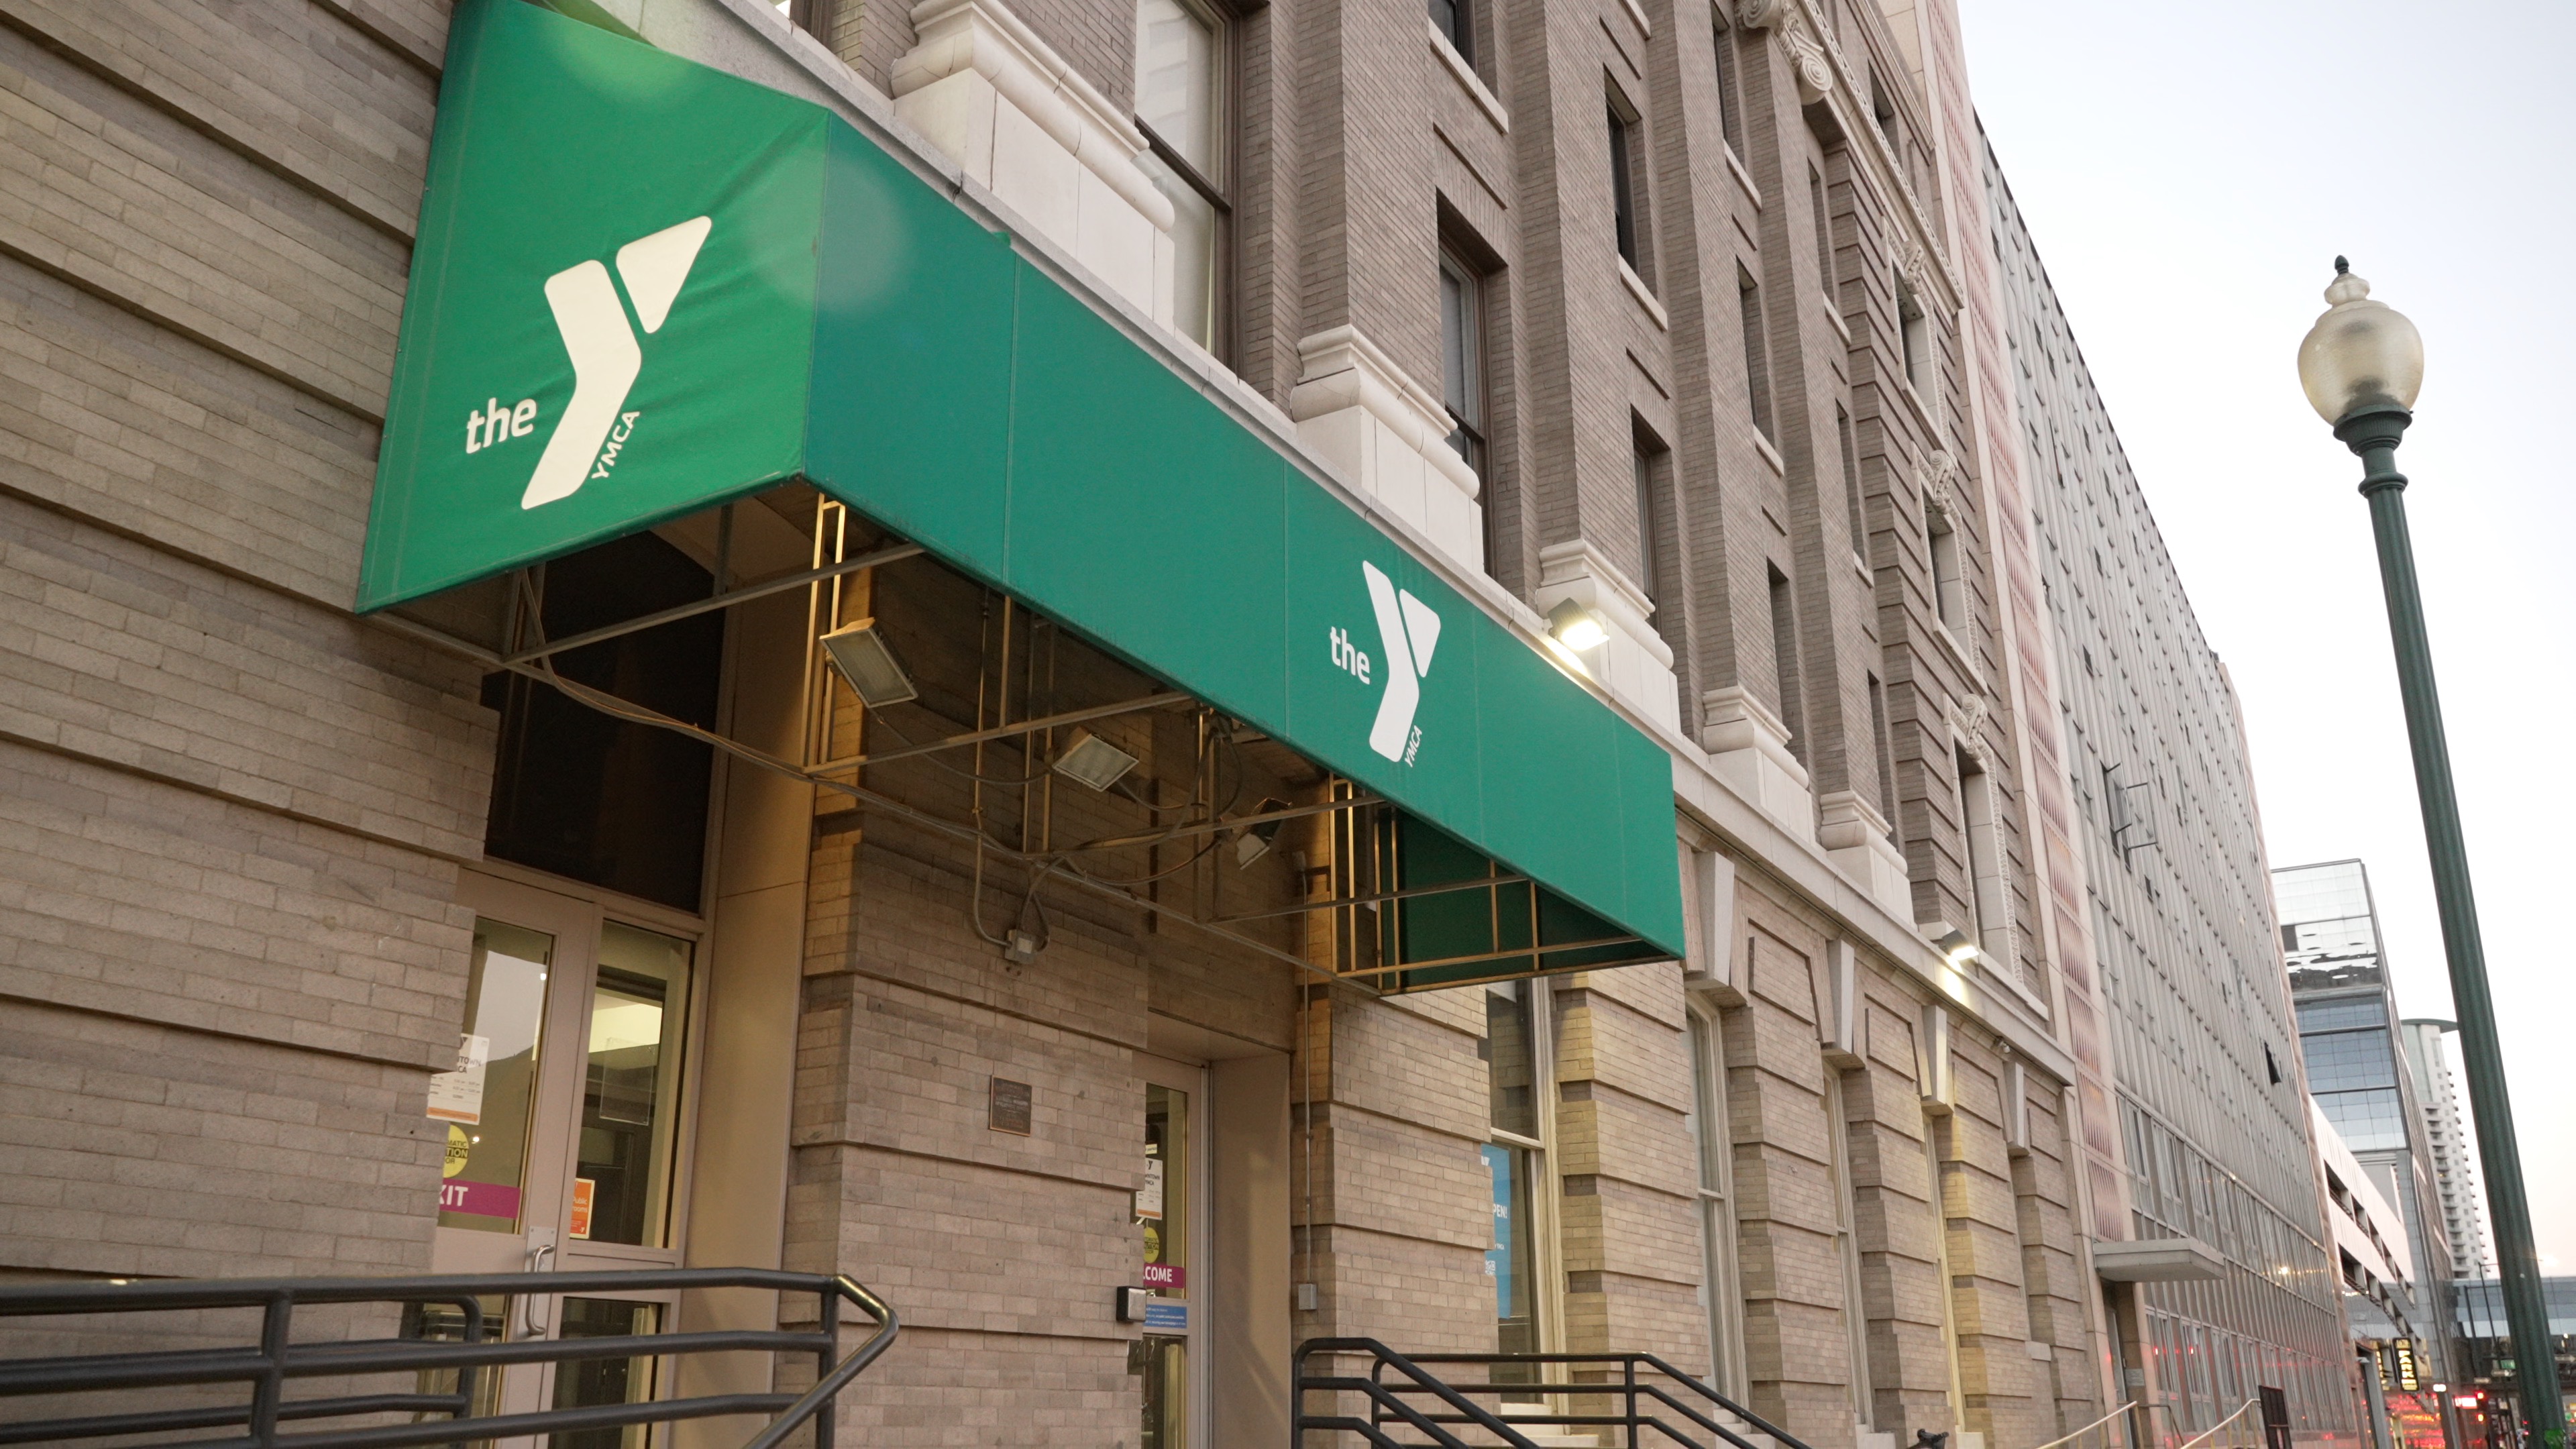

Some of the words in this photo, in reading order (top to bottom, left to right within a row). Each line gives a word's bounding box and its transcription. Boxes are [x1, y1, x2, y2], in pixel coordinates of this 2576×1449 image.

[466, 397, 538, 454] the
[590, 410, 641, 480] YMCA
[1330, 626, 1371, 685] the
[1404, 725, 1423, 768] YMCA
[1143, 1266, 1173, 1283] COME
